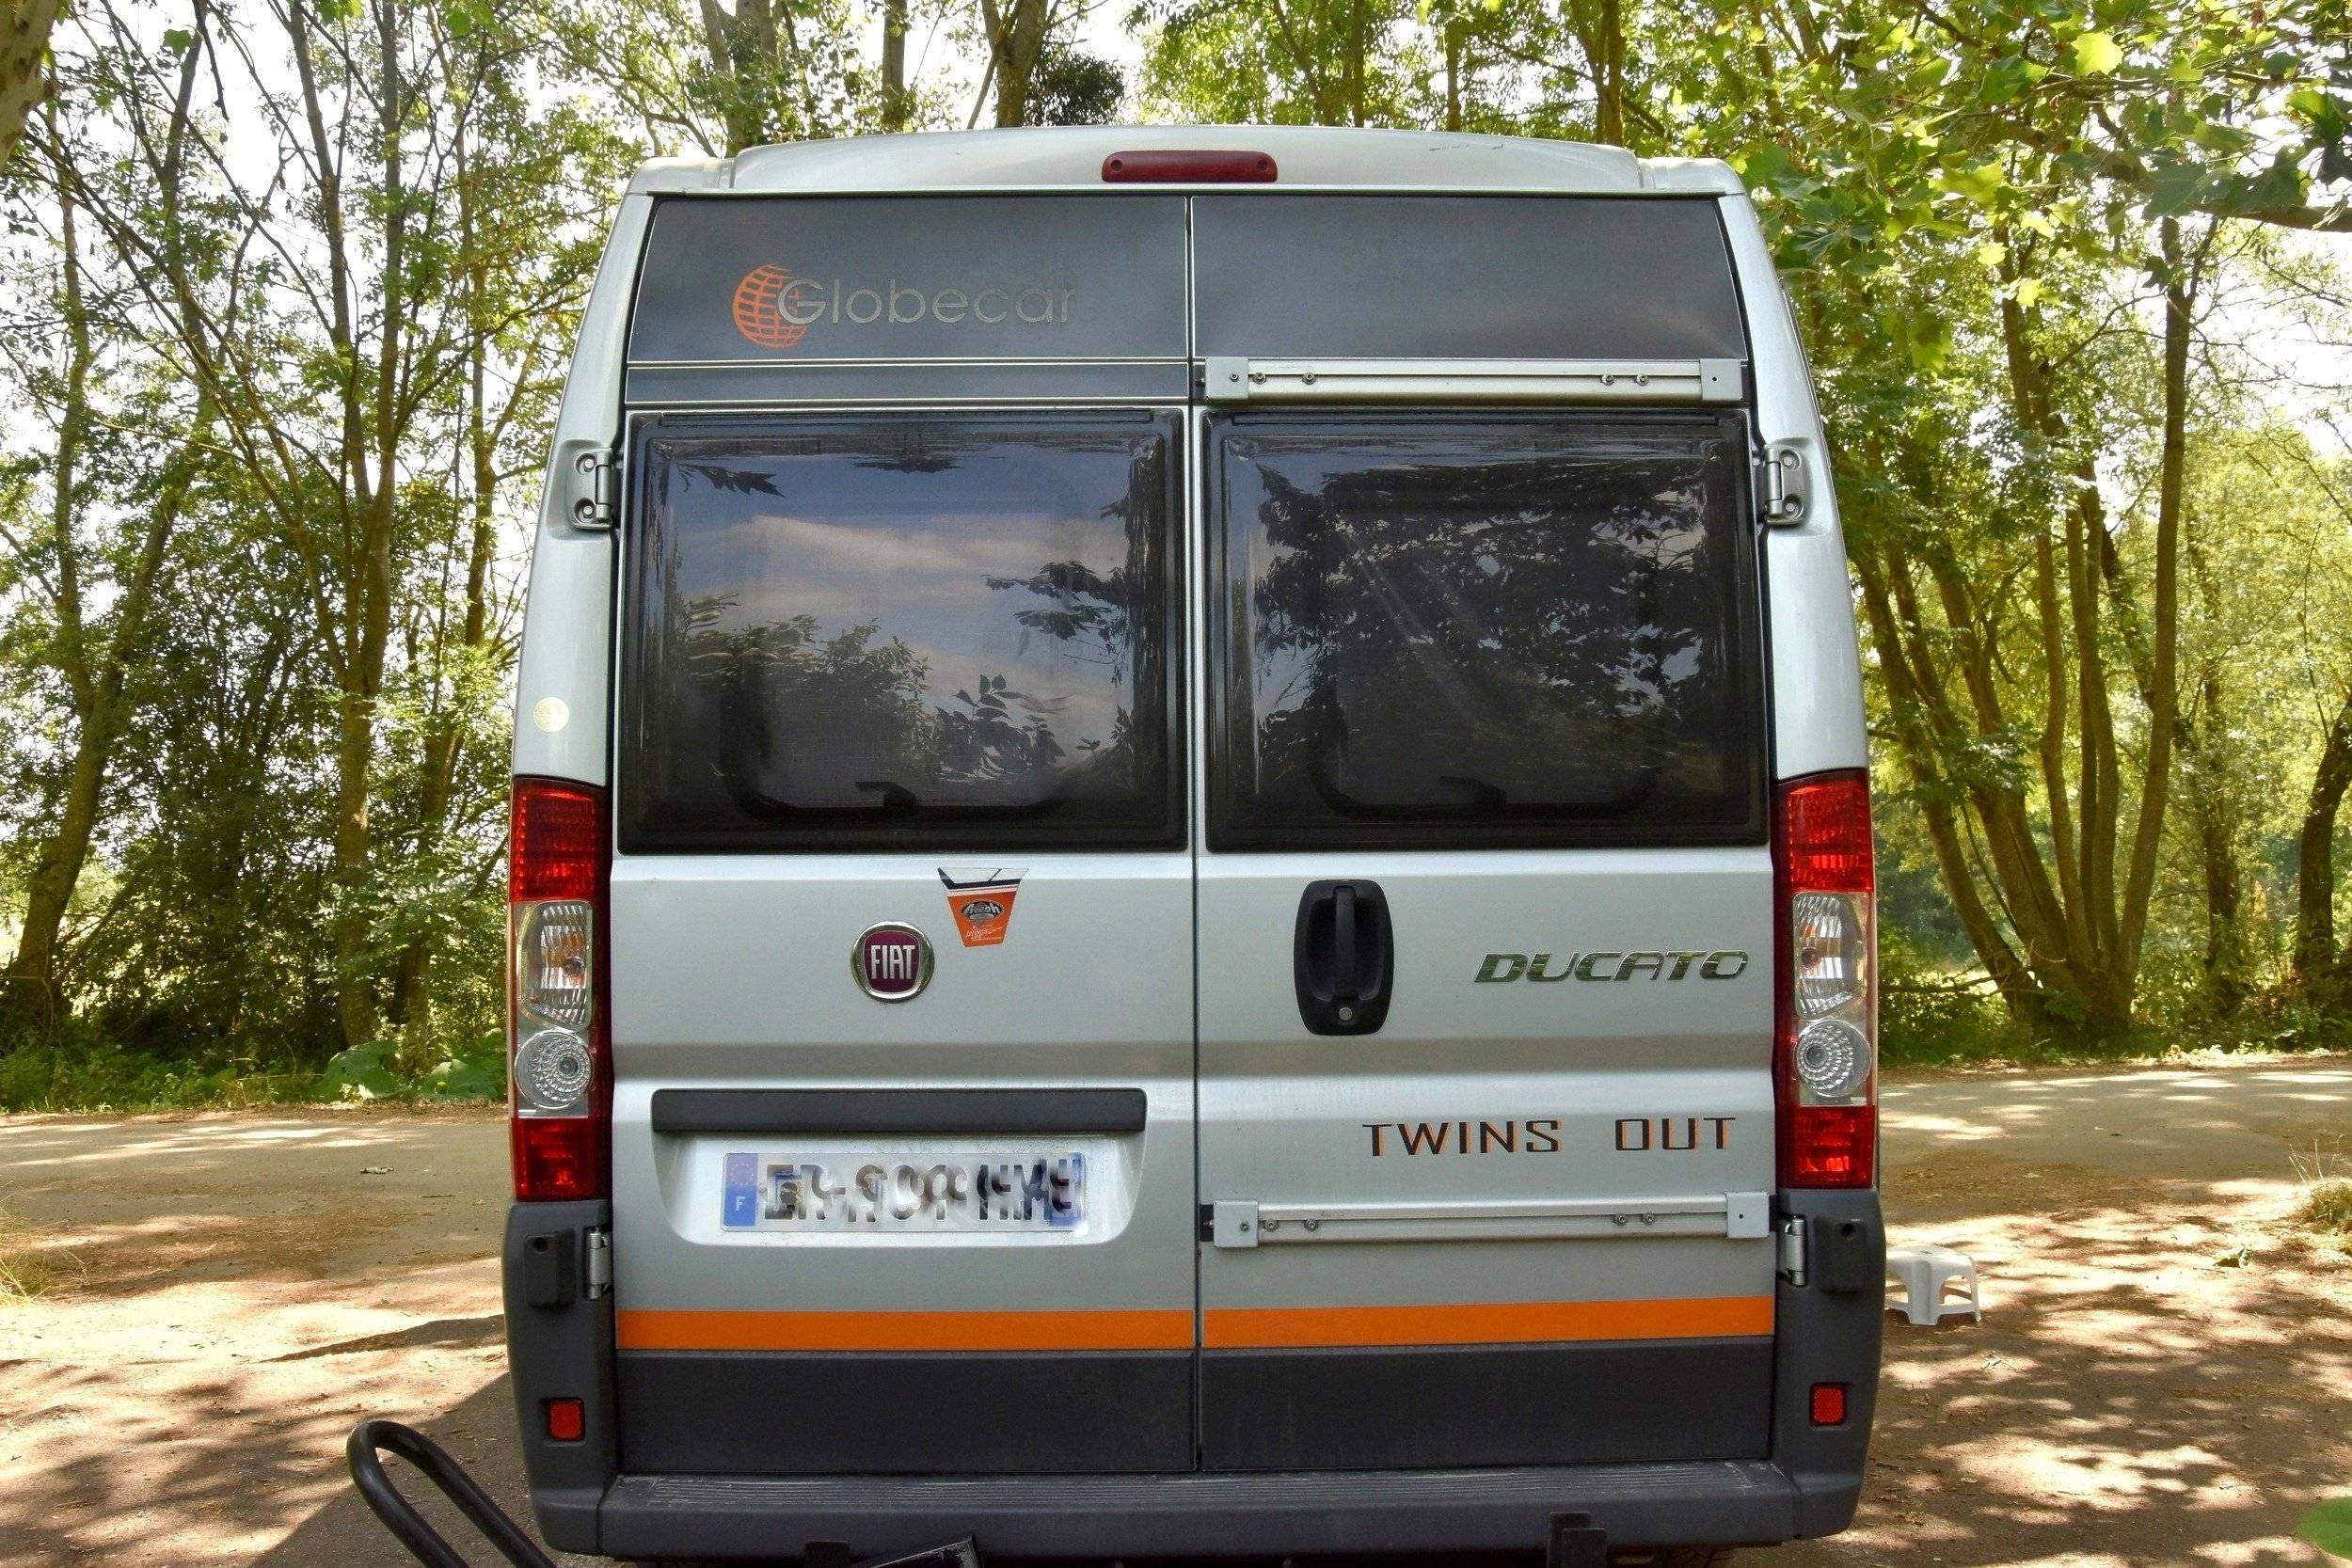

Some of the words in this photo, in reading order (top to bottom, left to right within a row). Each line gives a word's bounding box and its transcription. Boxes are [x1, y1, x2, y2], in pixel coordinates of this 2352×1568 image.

[778, 278, 1077, 325] Globecar
[870, 944, 915, 980] FIAT
[1472, 949, 1749, 983] DUCATO
[1362, 1119, 1565, 1158] TWINS
[1614, 1117, 1737, 1152] OUT
[736, 1196, 746, 1212] F
